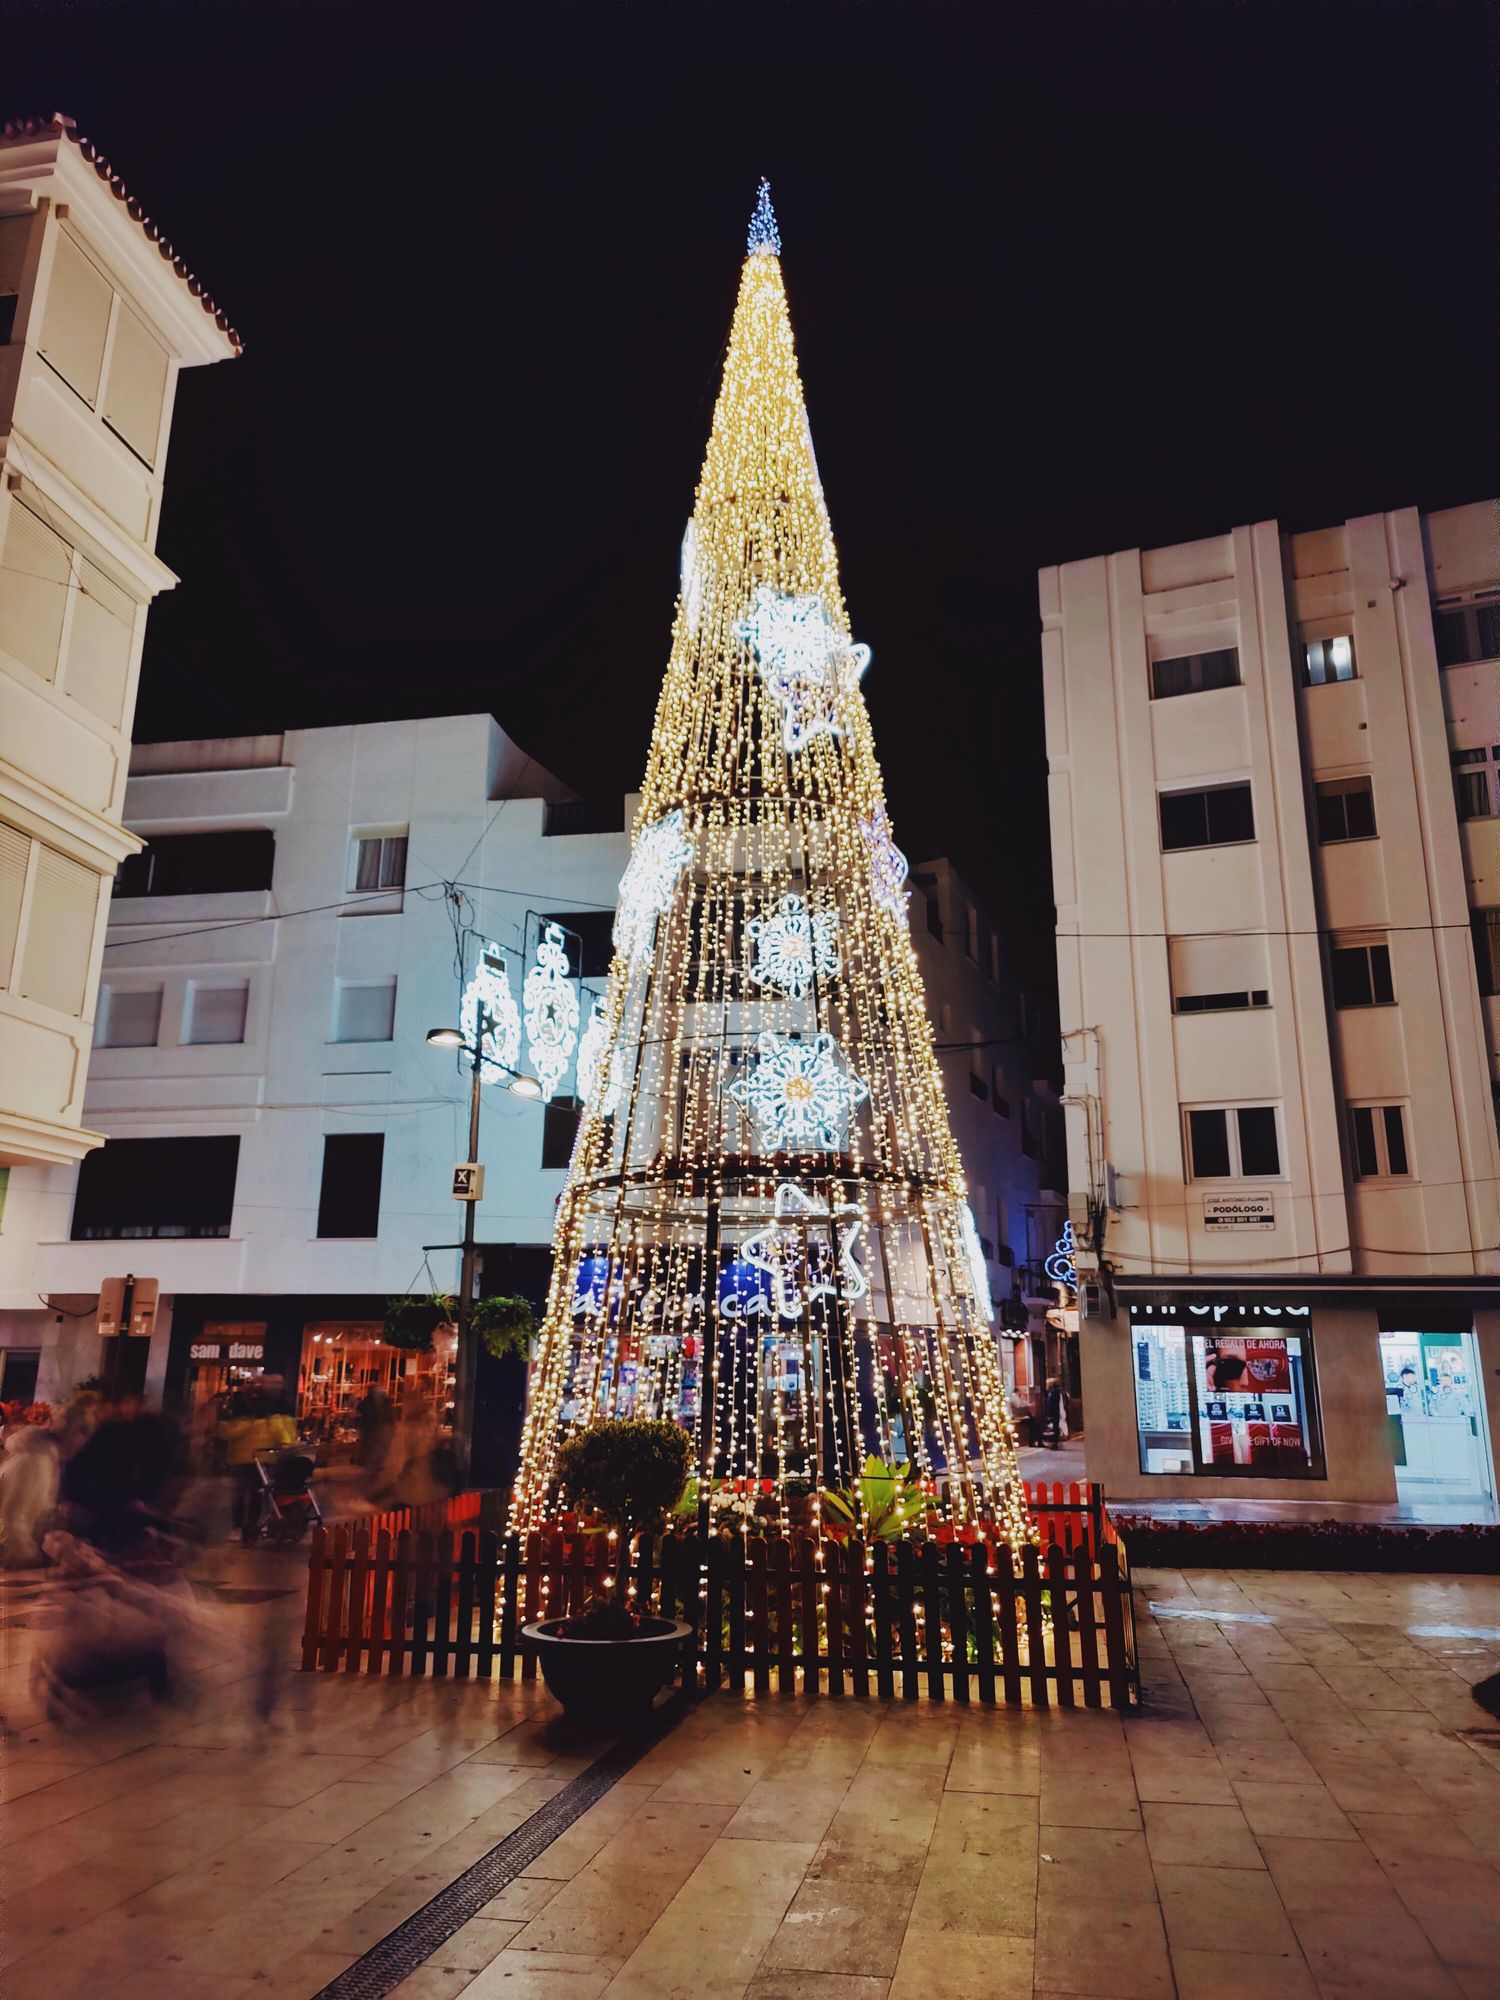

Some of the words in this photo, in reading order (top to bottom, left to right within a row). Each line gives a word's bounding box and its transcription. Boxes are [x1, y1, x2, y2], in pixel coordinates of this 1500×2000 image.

[1213, 1205, 1264, 1213] PODÓLOGO
[1204, 1338, 1214, 1349] EL
[1215, 1338, 1244, 1349] REGALO
[1246, 1339, 1257, 1349] DE
[1258, 1339, 1286, 1350] AHORA
[190, 1344, 220, 1359] sam
[228, 1342, 264, 1359] dave
[1220, 1435, 1233, 1446] GIV
[1254, 1436, 1270, 1447] GIFT
[1272, 1436, 1281, 1447] OF
[1283, 1437, 1301, 1448] NOW
